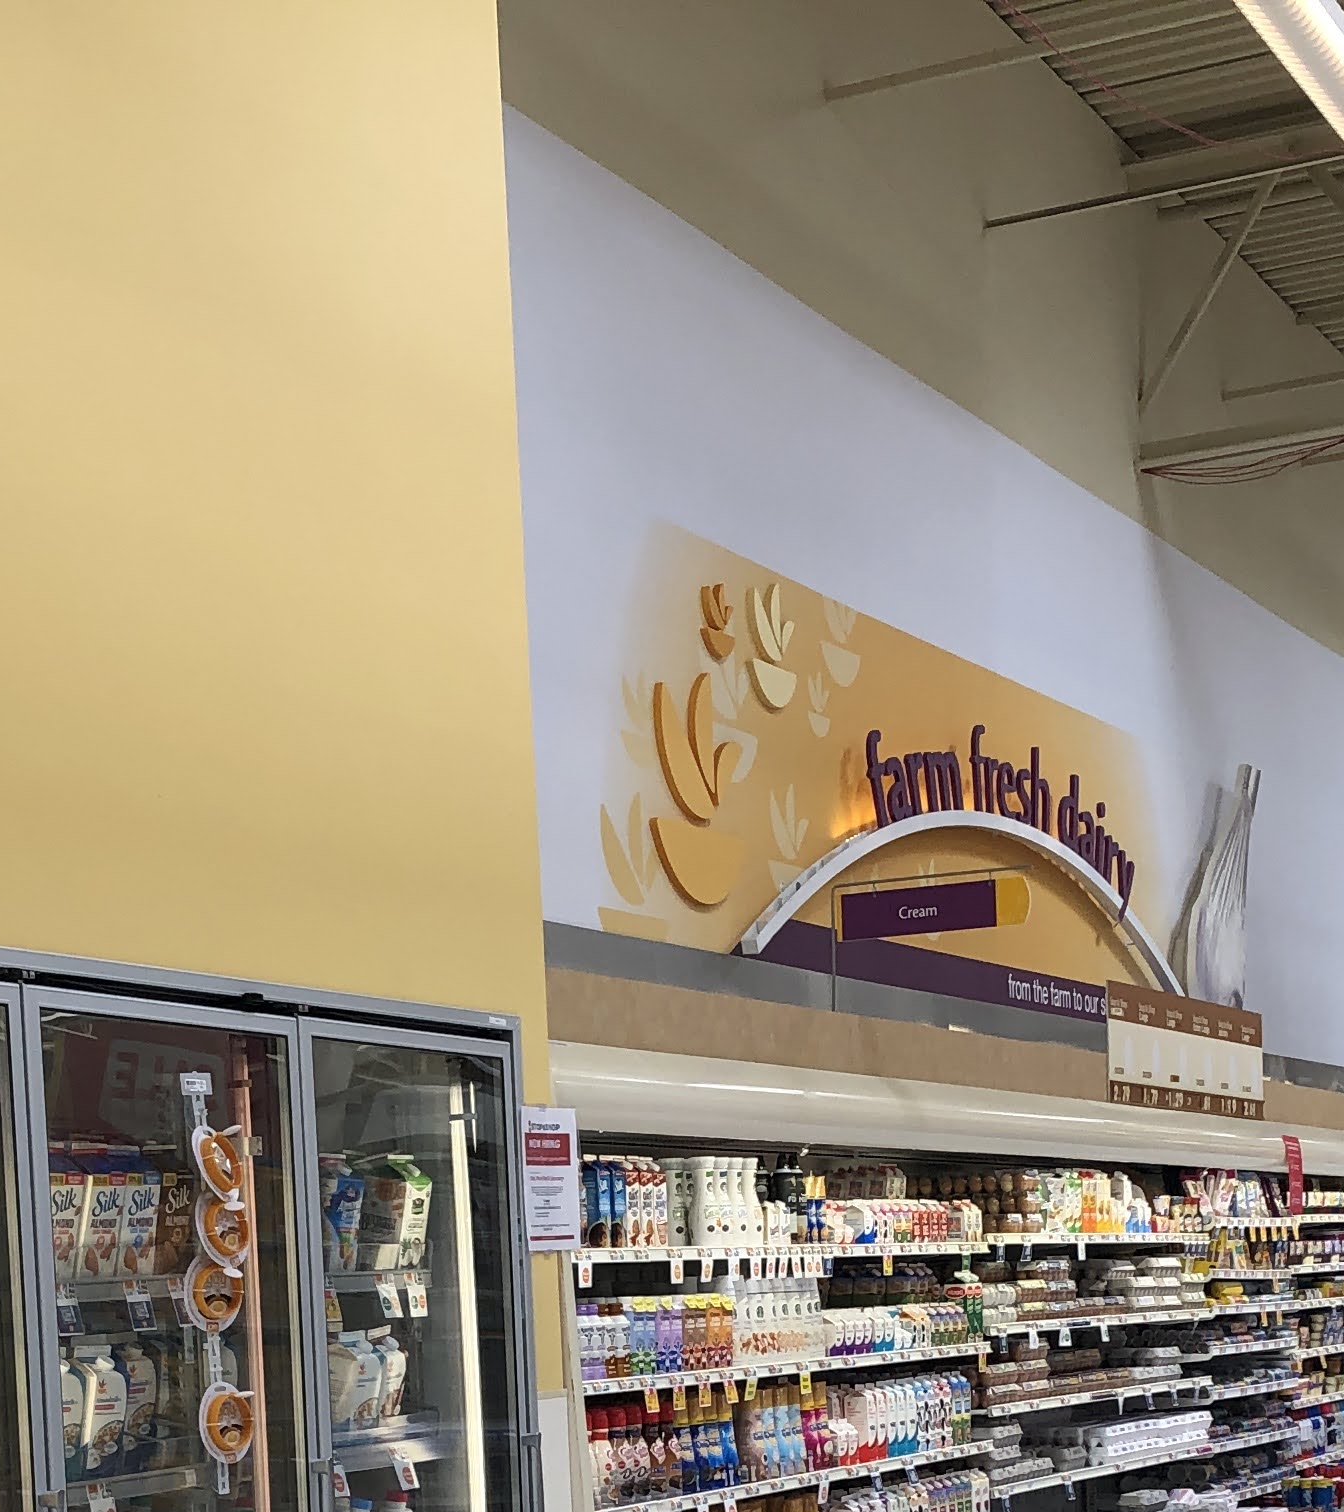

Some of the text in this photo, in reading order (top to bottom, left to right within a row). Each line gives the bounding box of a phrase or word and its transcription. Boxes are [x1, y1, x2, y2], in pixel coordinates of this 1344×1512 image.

[867, 725, 1135, 922] farm fresh dairy
[898, 903, 938, 920] Cream
[1008, 973, 1031, 1001] from
[1033, 979, 1048, 1004] the
[1050, 982, 1071, 1009] farm
[1073, 988, 1082, 1011] to
[1085, 994, 1098, 1013] our
[51, 1190, 77, 1214] Silk
[92, 1190, 119, 1217] Silk
[128, 1188, 155, 1215] Silk
[165, 1185, 190, 1214] Silk
[90, 1218, 116, 1229] ALMOND
[127, 1217, 153, 1228] ALMOND
